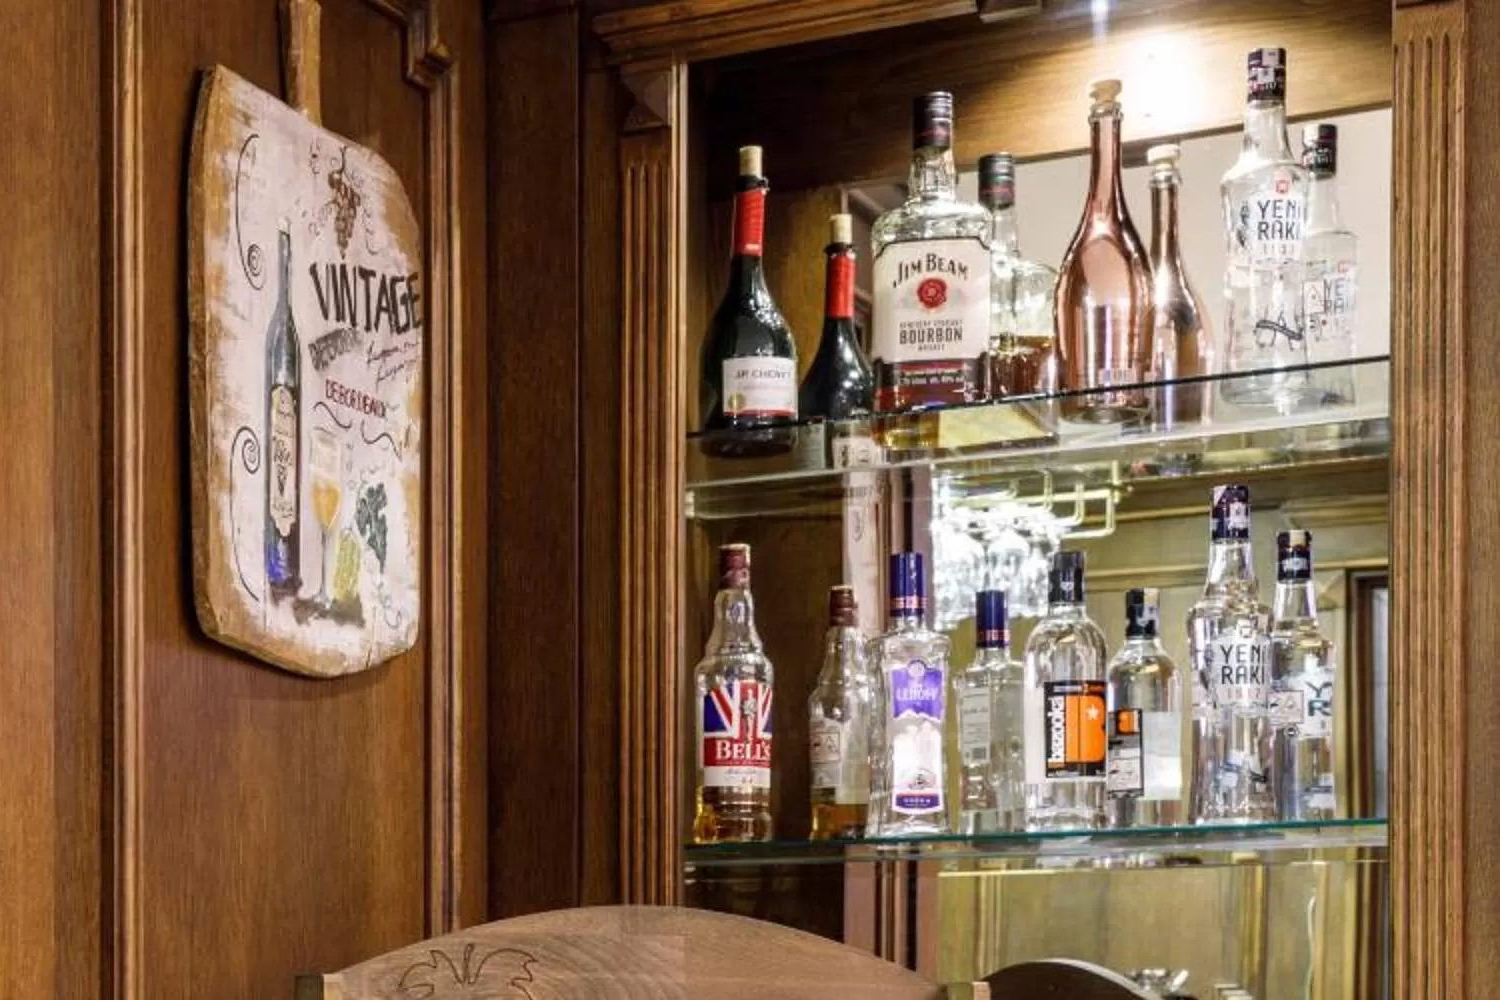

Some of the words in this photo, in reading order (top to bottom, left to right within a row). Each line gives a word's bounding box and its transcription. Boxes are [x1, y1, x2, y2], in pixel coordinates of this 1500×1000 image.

[893, 260, 922, 289] JIM
[926, 252, 968, 281] BEAM
[309, 262, 422, 335] VINTAGE
[899, 327, 963, 345] BOURBON
[1221, 665, 1266, 685] RAKI
[715, 740, 772, 761] BELL'S
